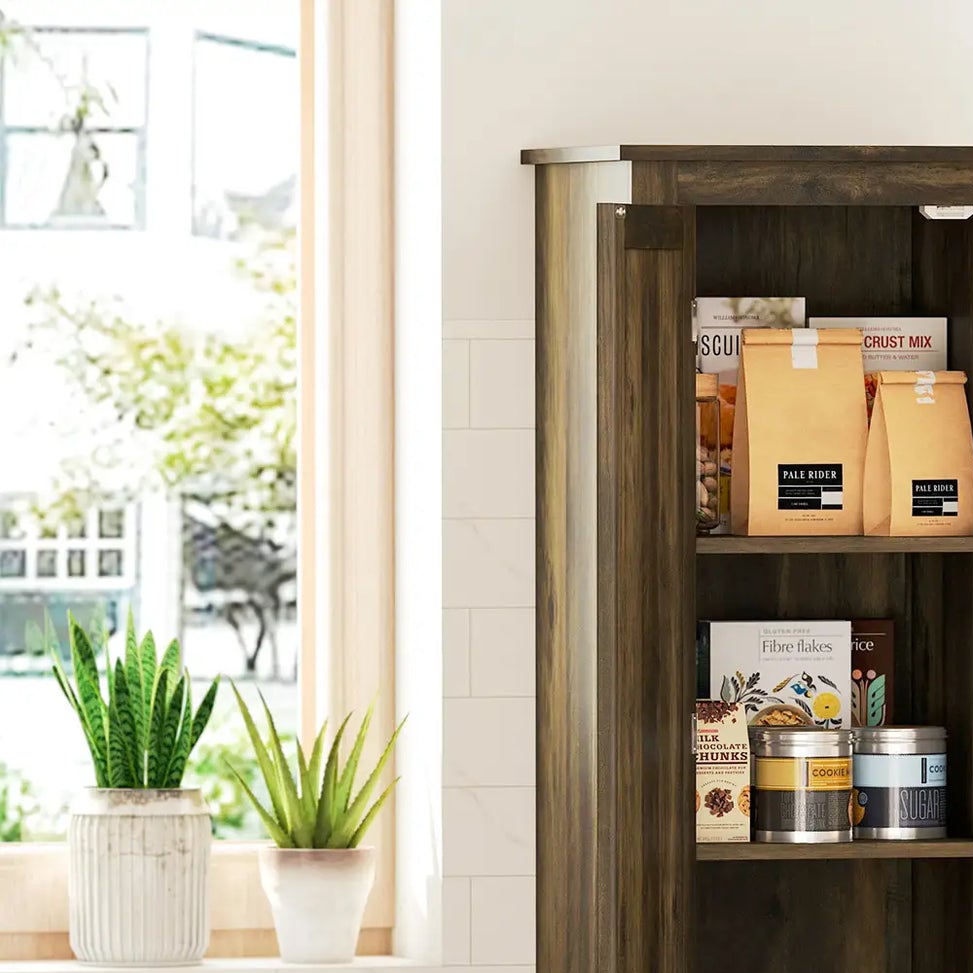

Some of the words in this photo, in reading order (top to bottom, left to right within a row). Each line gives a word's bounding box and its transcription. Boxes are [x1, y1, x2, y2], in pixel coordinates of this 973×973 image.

[864, 335, 905, 349] CRUST
[909, 335, 932, 349] MIX
[783, 470, 806, 479] PALE
[808, 470, 837, 479] RIDER
[915, 484, 932, 492] PALE
[933, 484, 954, 492] RIDER
[762, 639, 794, 653] Fibre
[797, 638, 833, 653] flakes
[812, 768, 845, 777] COOKIE
[900, 789, 940, 820] SUGAR
